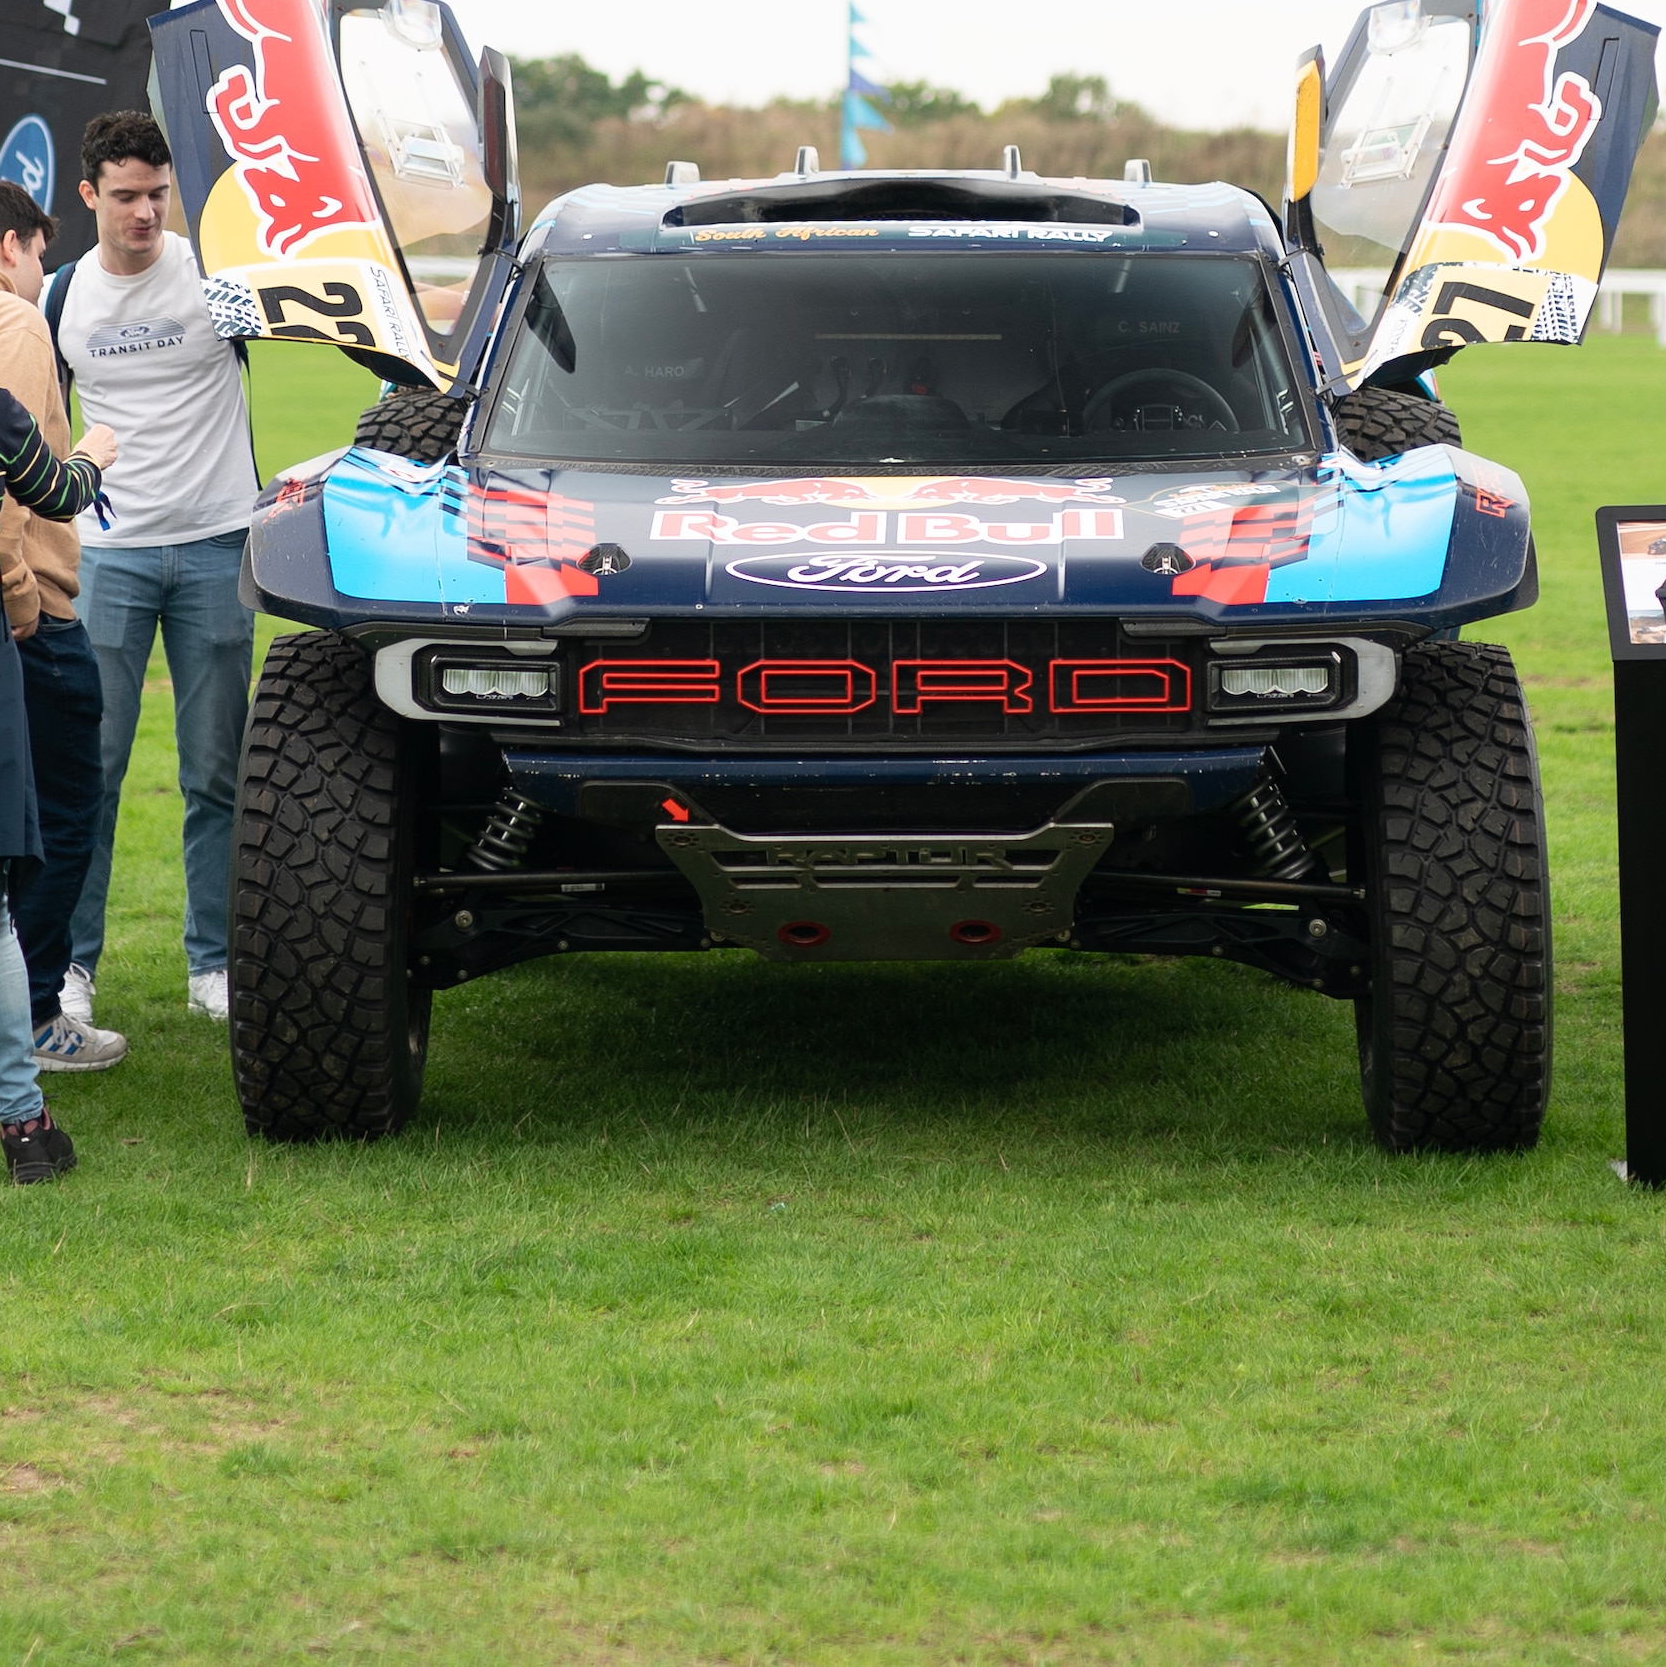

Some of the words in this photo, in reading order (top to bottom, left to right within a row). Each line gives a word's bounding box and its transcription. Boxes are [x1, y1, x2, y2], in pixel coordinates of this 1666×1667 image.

[694, 228, 767, 242] South
[775, 226, 880, 241] African
[908, 225, 1022, 238] SAFARI
[1027, 229, 1114, 243] RALLY
[369, 266, 396, 320] SAFARI
[1139, 320, 1181, 334] SAINZ
[90, 341, 152, 358] TRANSIT
[157, 335, 184, 349] DAY
[644, 365, 685, 378] HARO
[649, 509, 886, 545] Red
[897, 508, 1125, 545] Bull
[787, 553, 986, 585] Ford
[579, 660, 1192, 714] FORD
[766, 846, 1015, 871] RAPTOR
